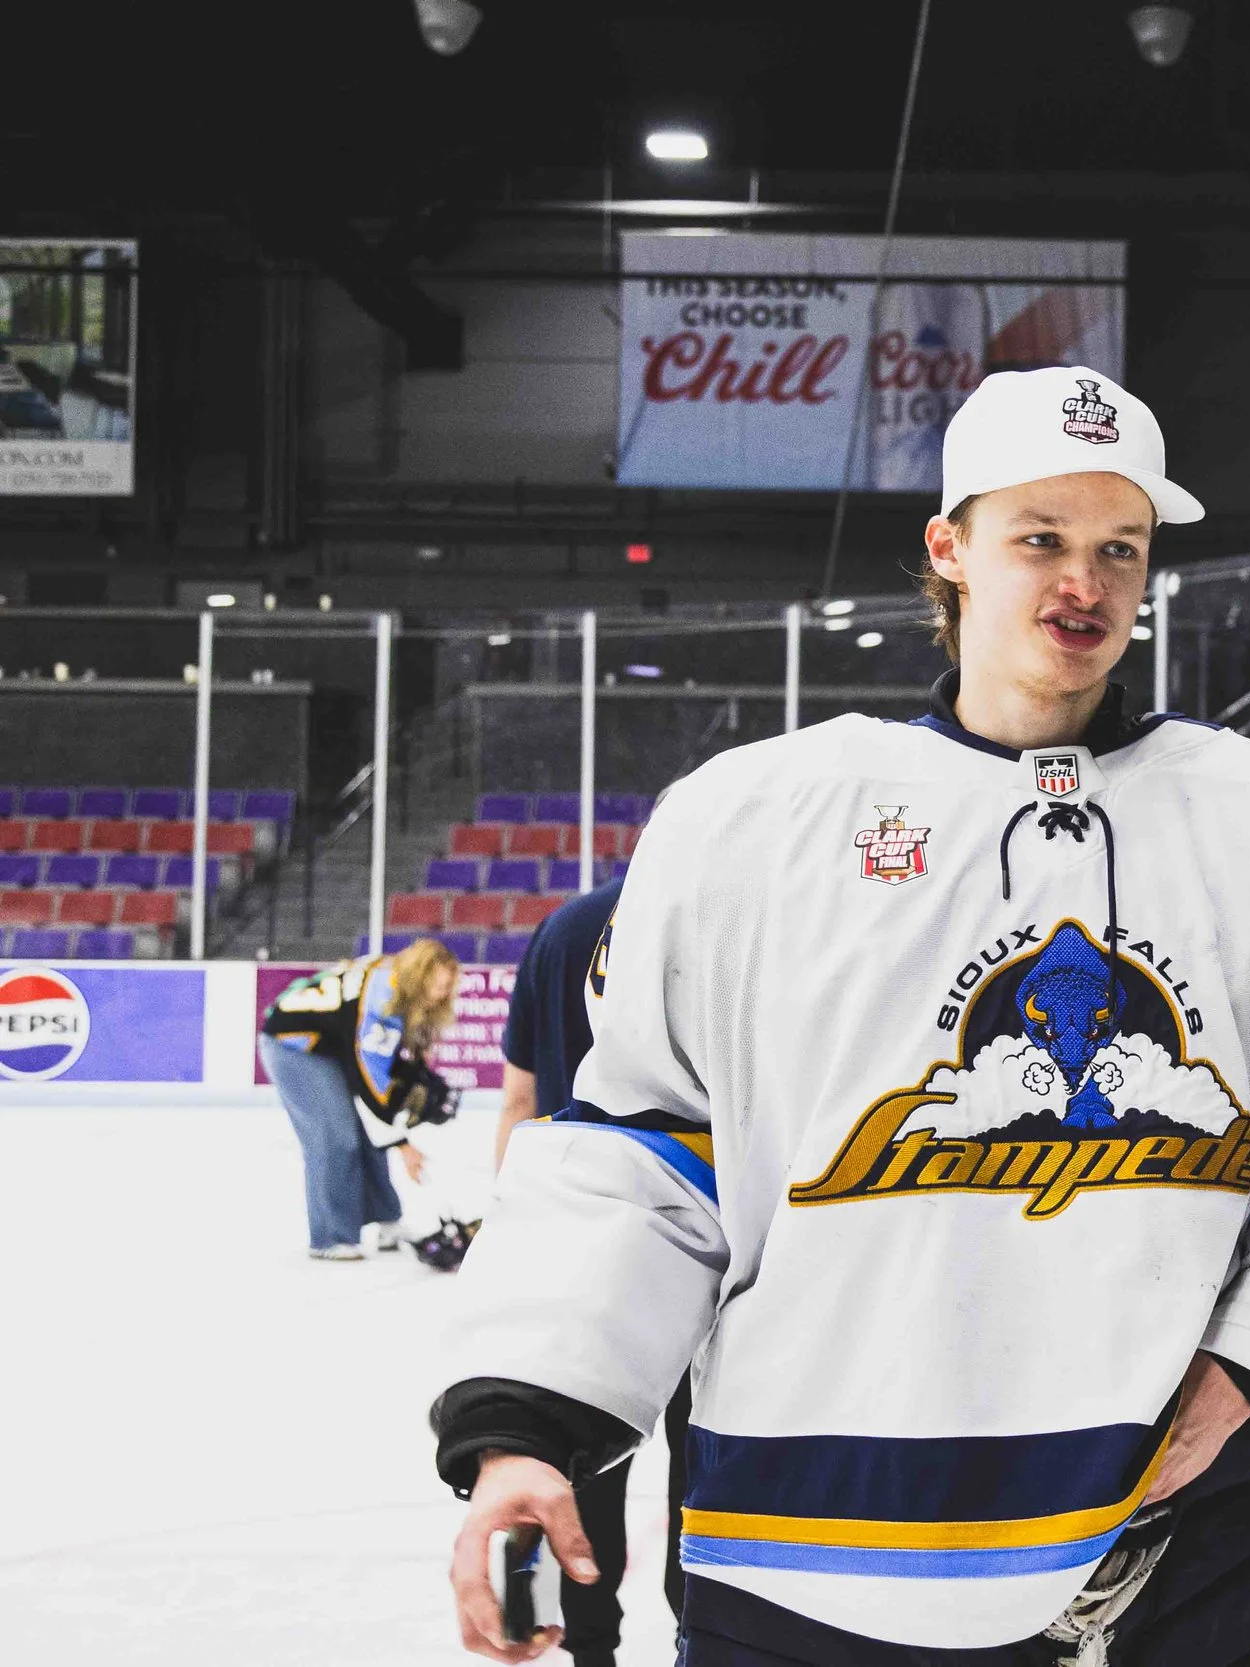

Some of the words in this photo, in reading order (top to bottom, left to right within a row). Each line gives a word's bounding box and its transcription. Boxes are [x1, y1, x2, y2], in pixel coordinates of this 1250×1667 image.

[647, 280, 709, 298] THIS
[681, 303, 809, 329] CHOOSE
[641, 332, 850, 404] Chill
[1063, 399, 1114, 417] CLARK
[1075, 411, 1107, 424] CUP
[1065, 421, 1117, 438] CHAMPIONS
[1040, 769, 1075, 778] USHL
[855, 828, 930, 846] CLARK
[868, 842, 915, 858] CUP
[878, 855, 908, 869] FINAL
[937, 923, 1042, 1032] SIOUX
[1103, 925, 1205, 1036] FALLS
[0, 1014, 78, 1032] EPSI
